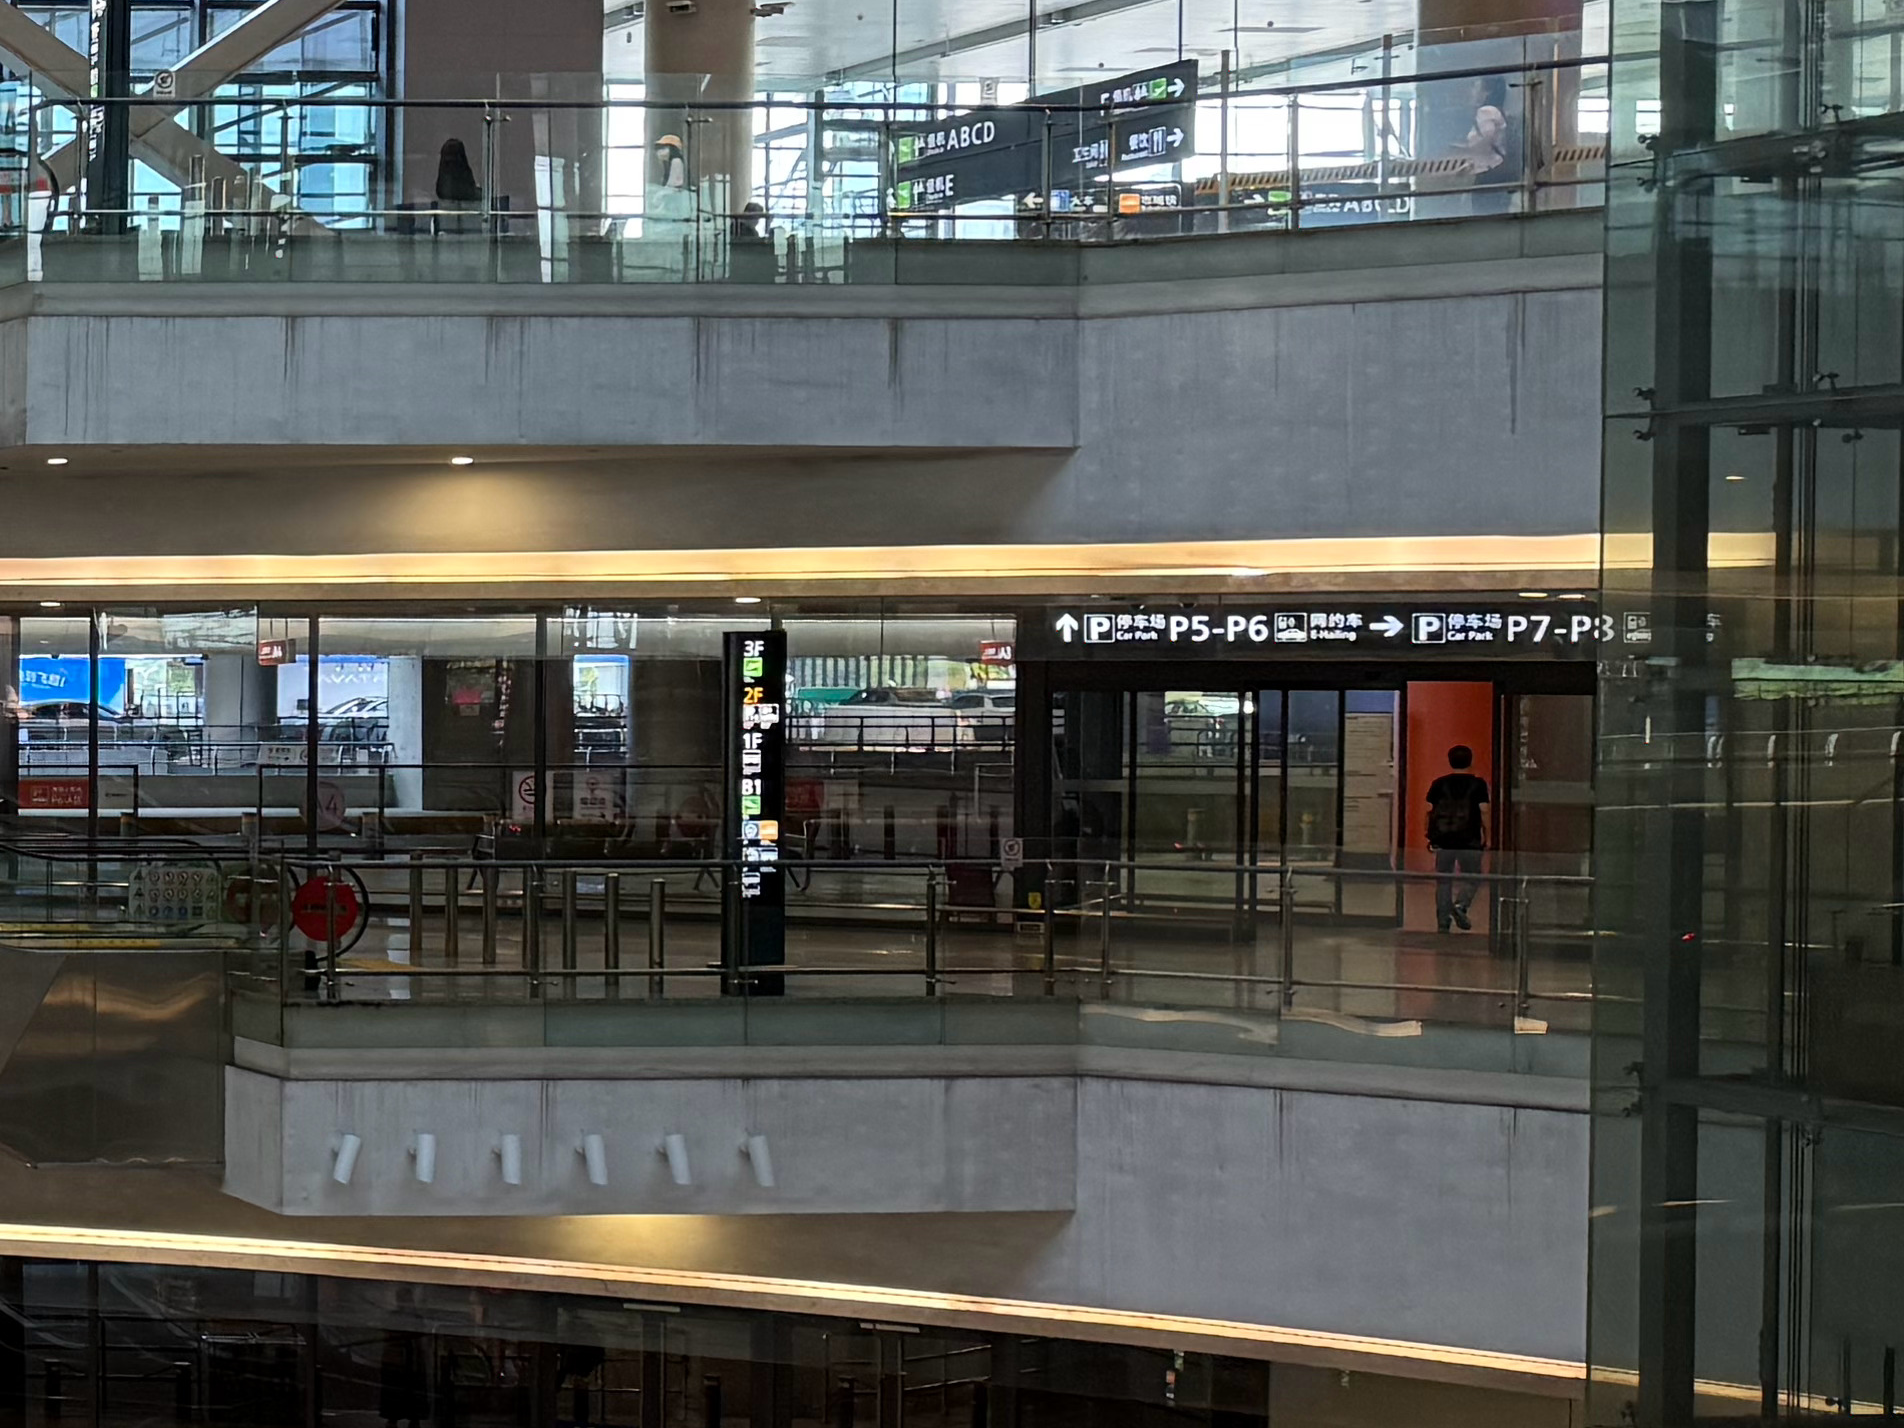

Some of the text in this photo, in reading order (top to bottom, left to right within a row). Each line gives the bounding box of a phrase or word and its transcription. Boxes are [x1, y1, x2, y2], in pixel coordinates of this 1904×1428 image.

[947, 121, 995, 150] ABCD
[944, 174, 955, 197] E
[1116, 613, 1166, 630] 停车场
[1170, 615, 1269, 643] P5-P6
[1310, 613, 1363, 629] 网约车
[1448, 613, 1502, 629] 停车场
[743, 640, 765, 657] 3F
[743, 687, 764, 704] 2F
[742, 732, 763, 749] 1F
[741, 779, 762, 796] B1
